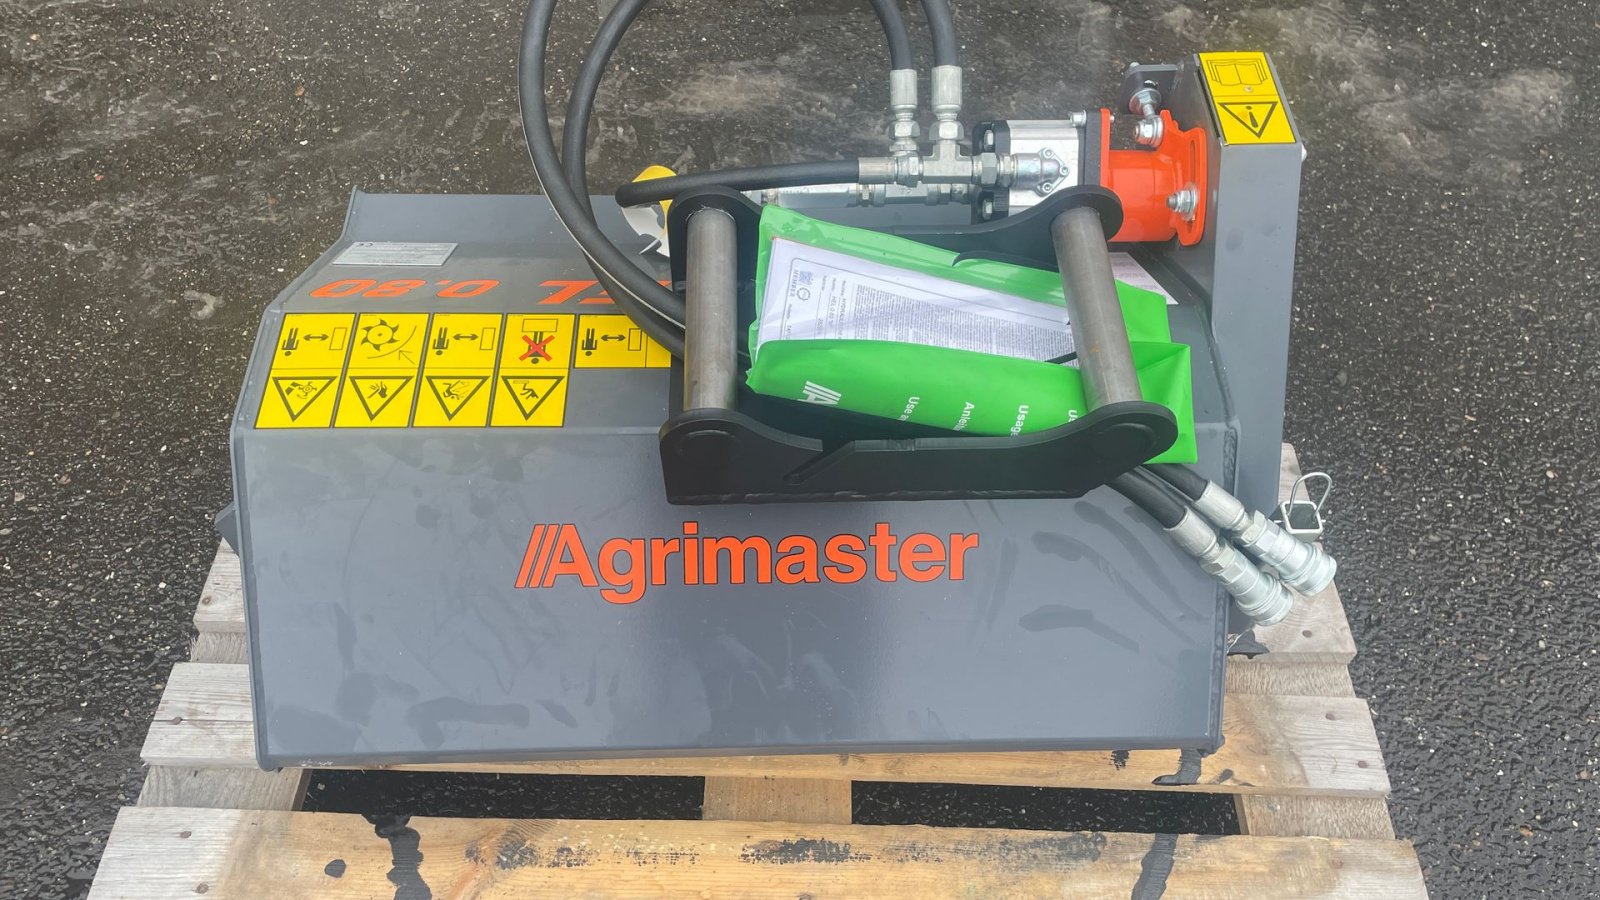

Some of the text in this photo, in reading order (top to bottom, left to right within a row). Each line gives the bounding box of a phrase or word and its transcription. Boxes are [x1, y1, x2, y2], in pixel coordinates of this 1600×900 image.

[309, 279, 500, 298] 0.80
[903, 396, 920, 414] Use
[542, 521, 979, 604] Agrimaster
